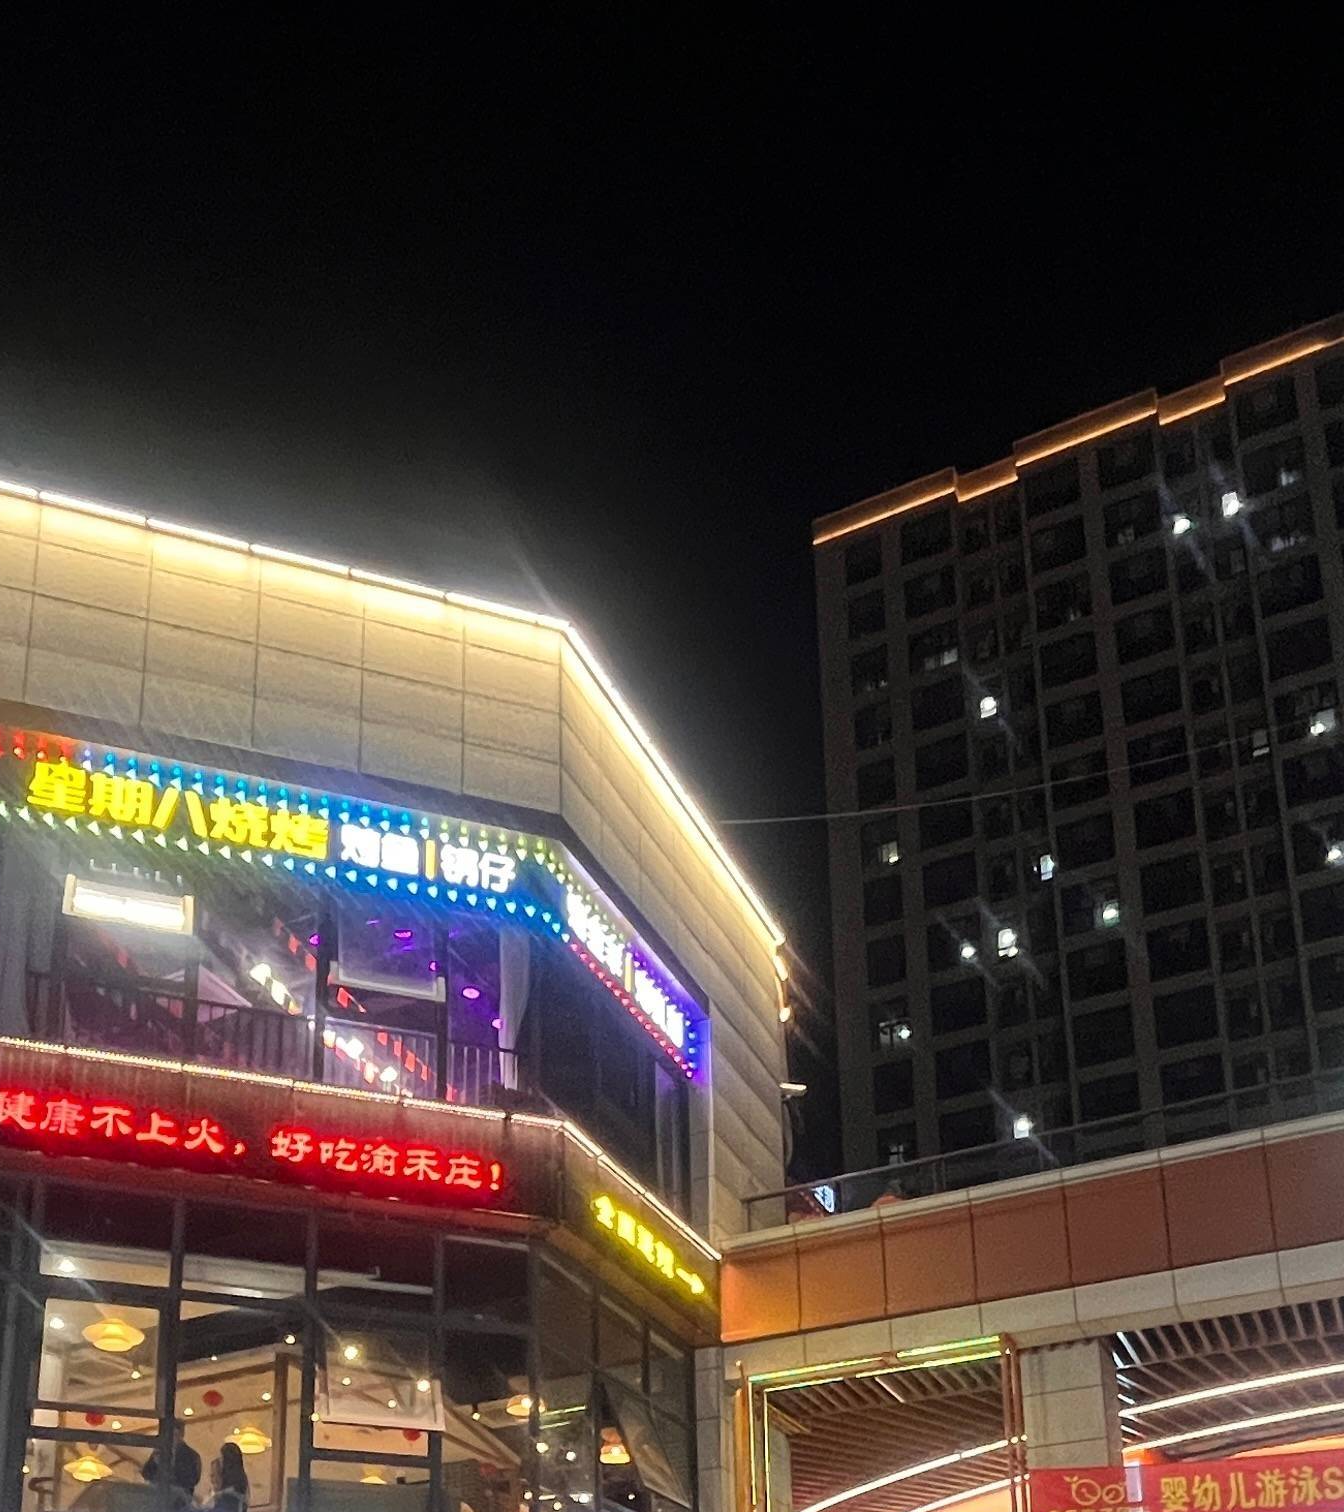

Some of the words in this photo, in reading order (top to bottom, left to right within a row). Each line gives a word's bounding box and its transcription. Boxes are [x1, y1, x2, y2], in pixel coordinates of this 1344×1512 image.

[27, 760, 330, 860] 星期八烧烤
